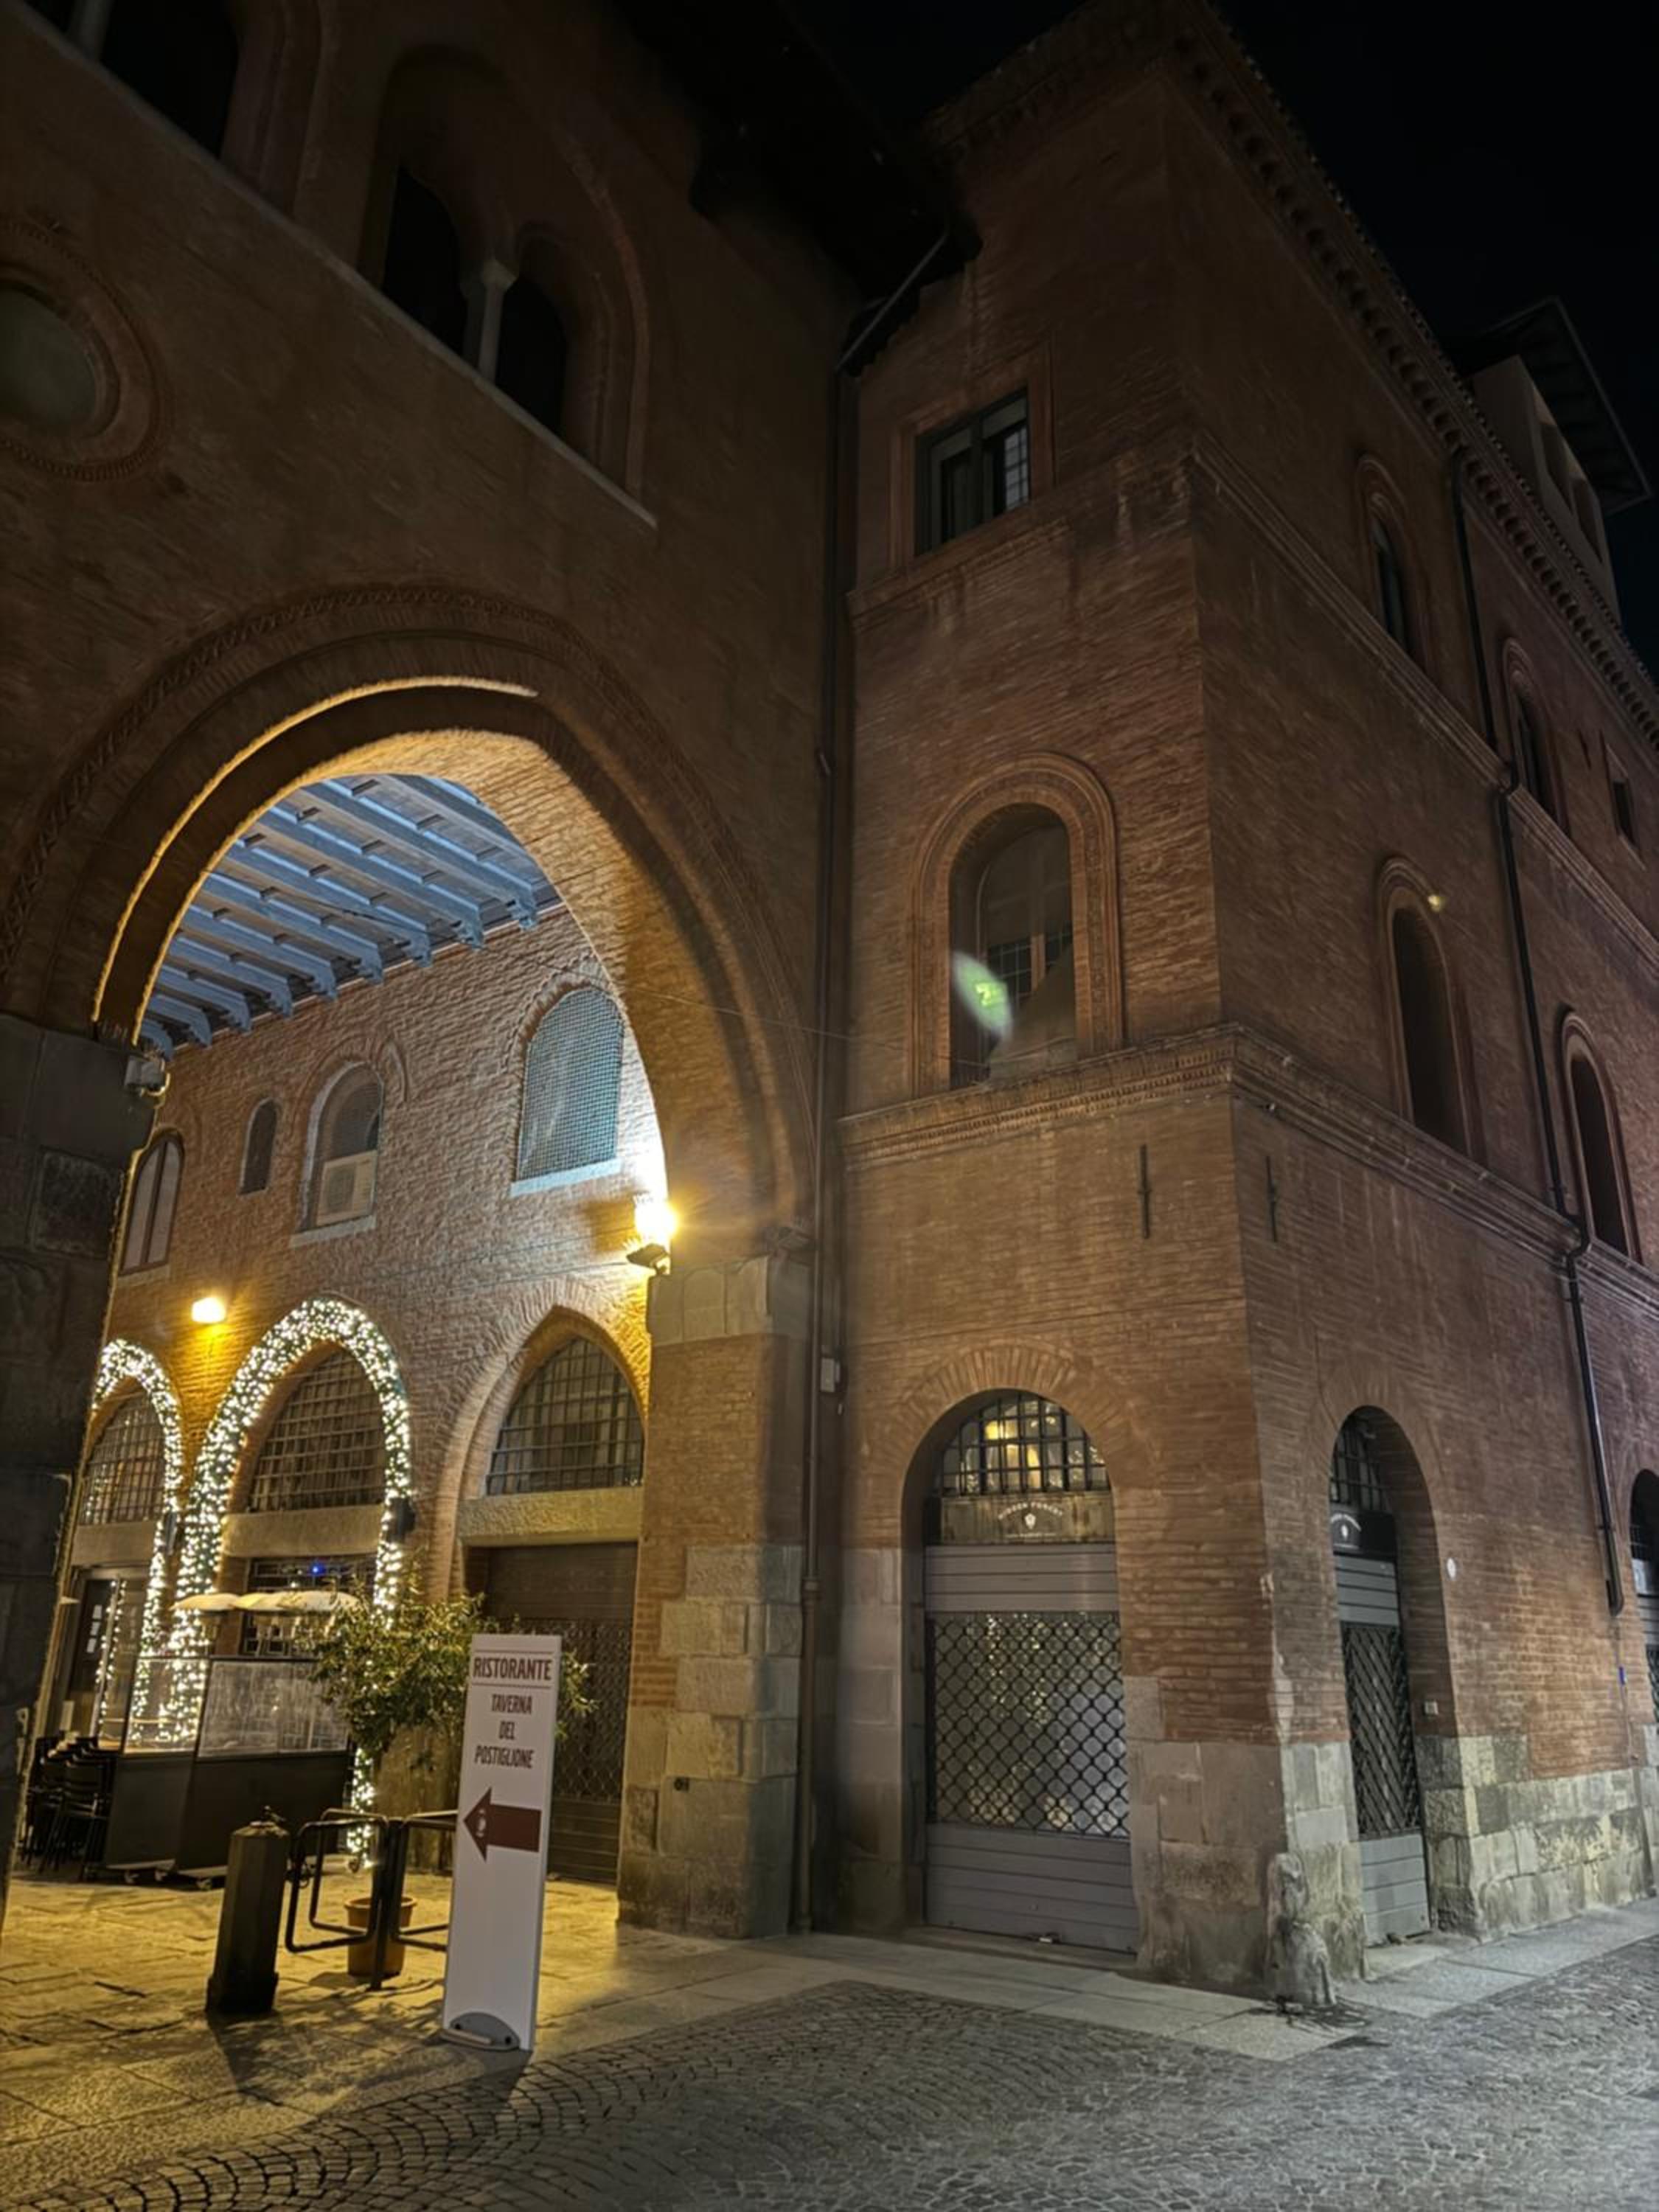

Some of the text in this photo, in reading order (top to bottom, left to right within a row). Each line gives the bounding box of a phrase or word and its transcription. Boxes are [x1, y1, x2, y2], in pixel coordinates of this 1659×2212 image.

[473, 1658, 552, 1680] RISTORANTE
[492, 1694, 532, 1714] TAVERNA
[499, 1721, 515, 1739] DEL
[475, 1745, 534, 1769] POSTIGLIONE
